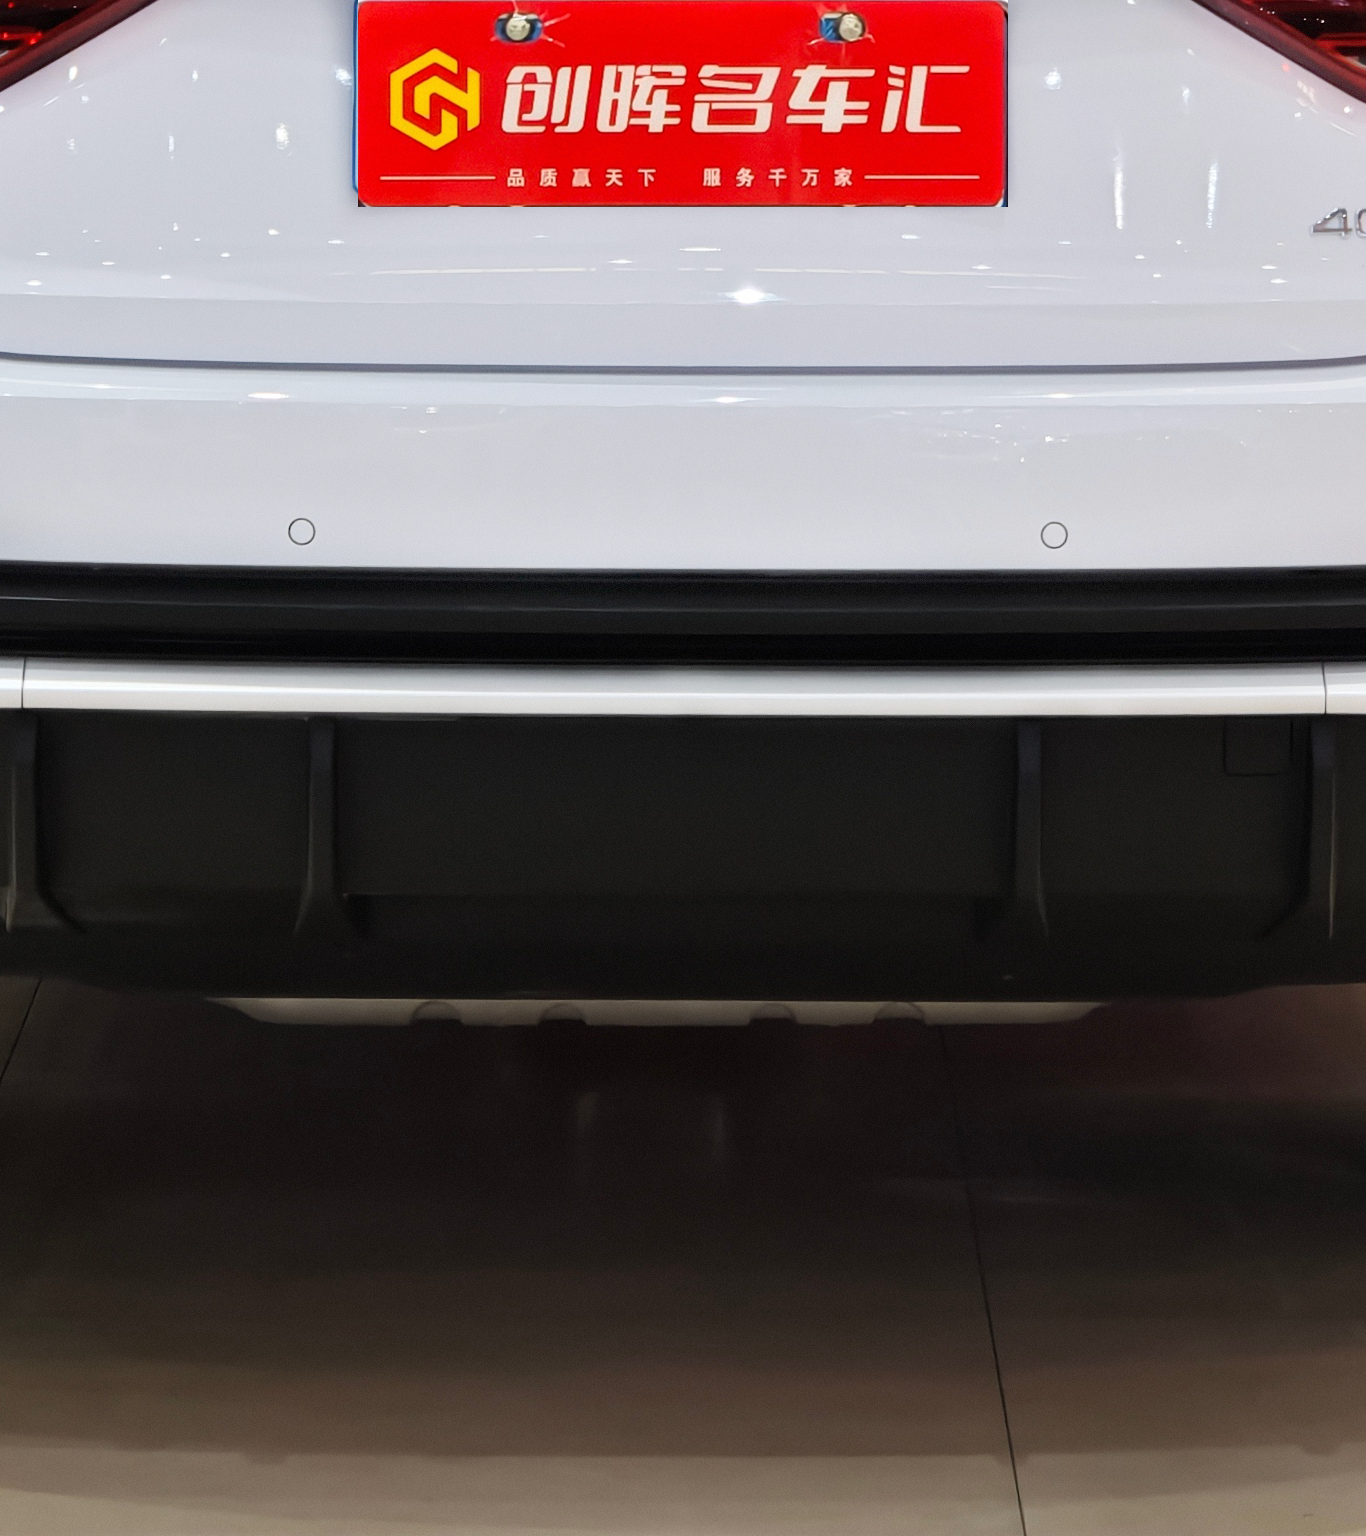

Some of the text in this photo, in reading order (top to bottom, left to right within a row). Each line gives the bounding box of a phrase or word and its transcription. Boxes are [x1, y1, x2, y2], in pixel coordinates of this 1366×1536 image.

[501, 65, 971, 135] 创晖名车汇
[507, 168, 854, 188] 品质赢天下 服务千万家
